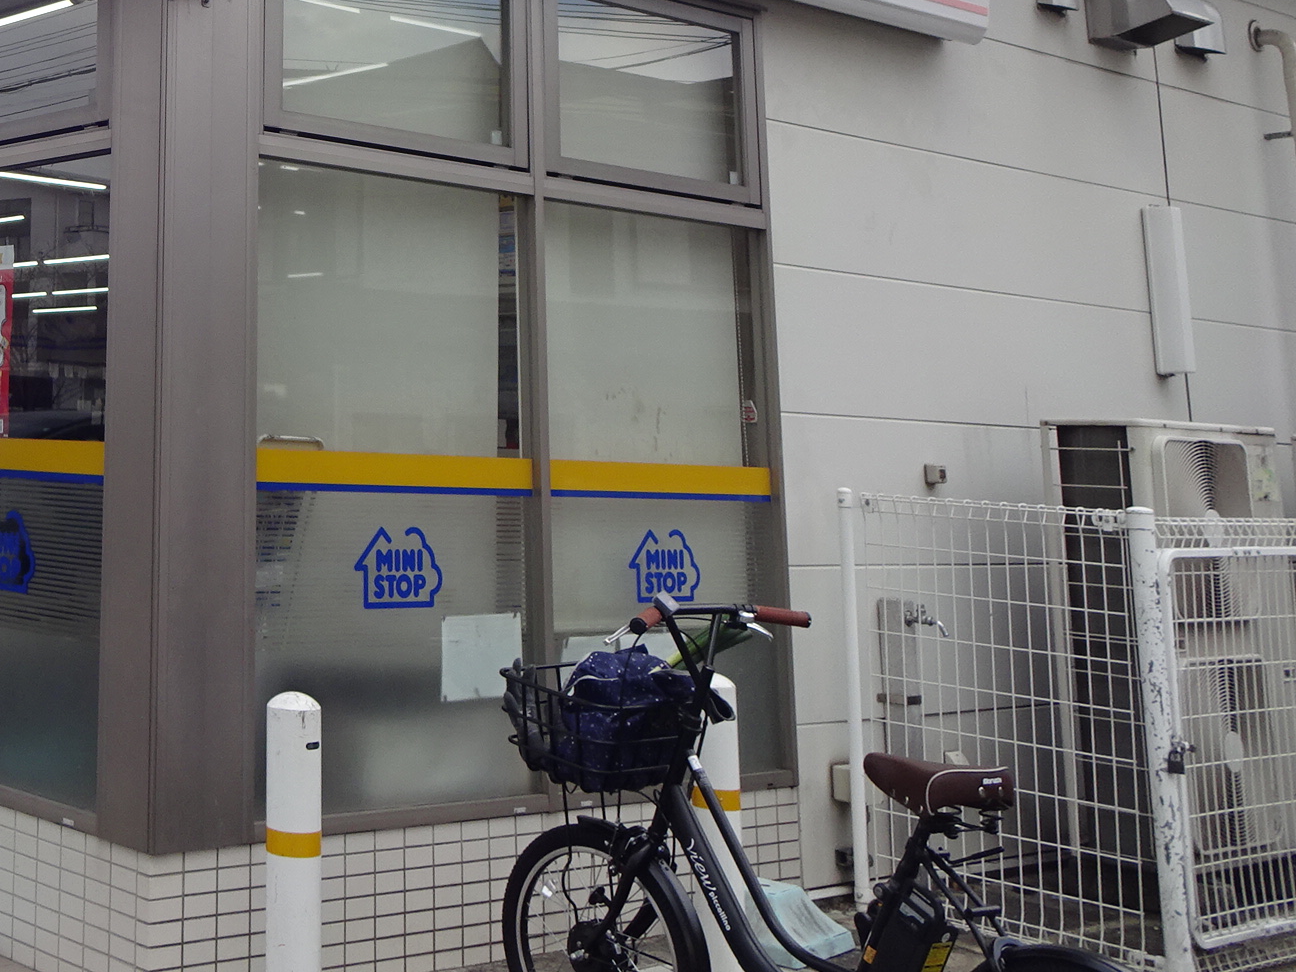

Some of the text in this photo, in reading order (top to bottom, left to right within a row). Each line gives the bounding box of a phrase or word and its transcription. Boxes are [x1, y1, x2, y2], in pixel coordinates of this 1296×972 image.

[376, 549, 423, 572] MINI
[646, 549, 684, 570] MINI
[374, 574, 426, 599] STOP
[645, 571, 687, 594] STOP
